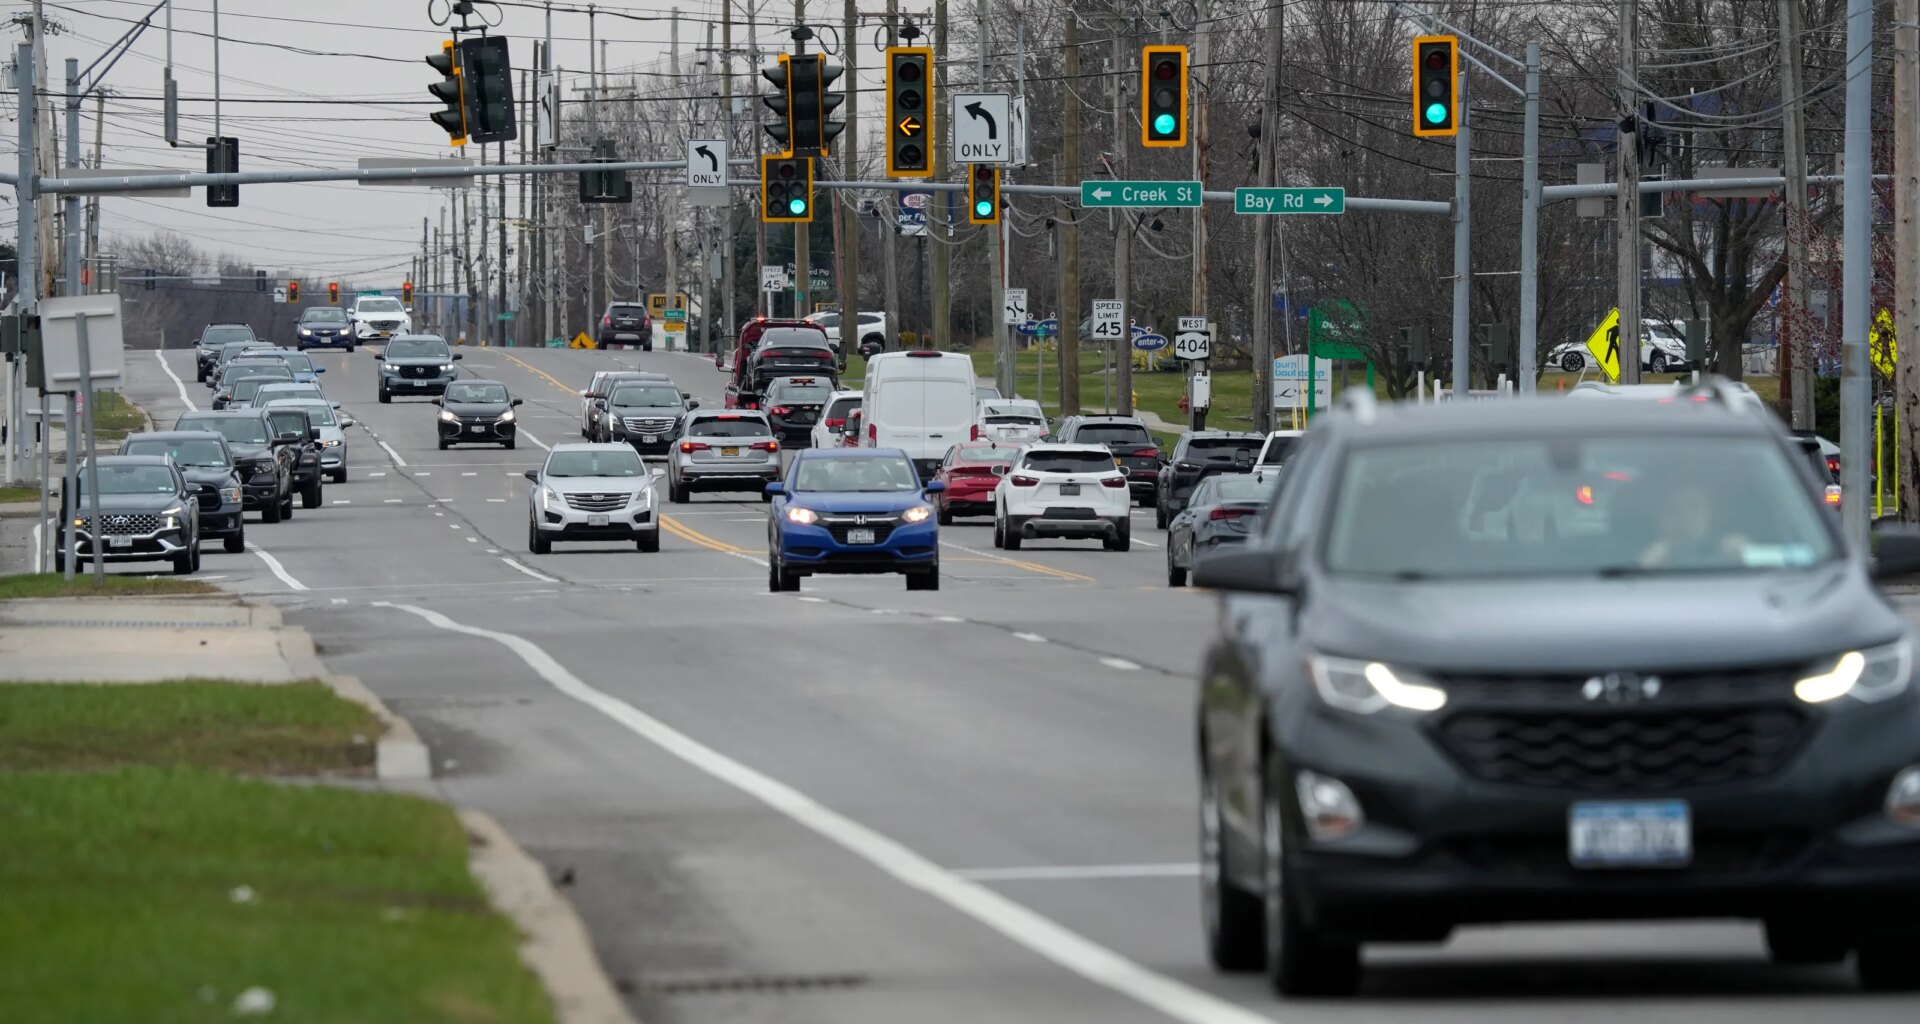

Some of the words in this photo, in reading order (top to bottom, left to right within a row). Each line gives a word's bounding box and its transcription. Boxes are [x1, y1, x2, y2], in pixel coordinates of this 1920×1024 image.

[962, 144, 1001, 157] ONLY
[693, 174, 721, 184] ONLY
[1122, 187, 1167, 201] Creek
[1177, 187, 1192, 201] St
[1245, 194, 1274, 211] Bay
[1284, 194, 1303, 208] Rd
[764, 280, 781, 289] 45
[1095, 322, 1121, 336] 45
[1182, 320, 1204, 328] WEST
[1138, 337, 1157, 346] enter
[1177, 339, 1208, 353] 404
[1274, 360, 1297, 369] burn
[1274, 368, 1296, 377] boot
